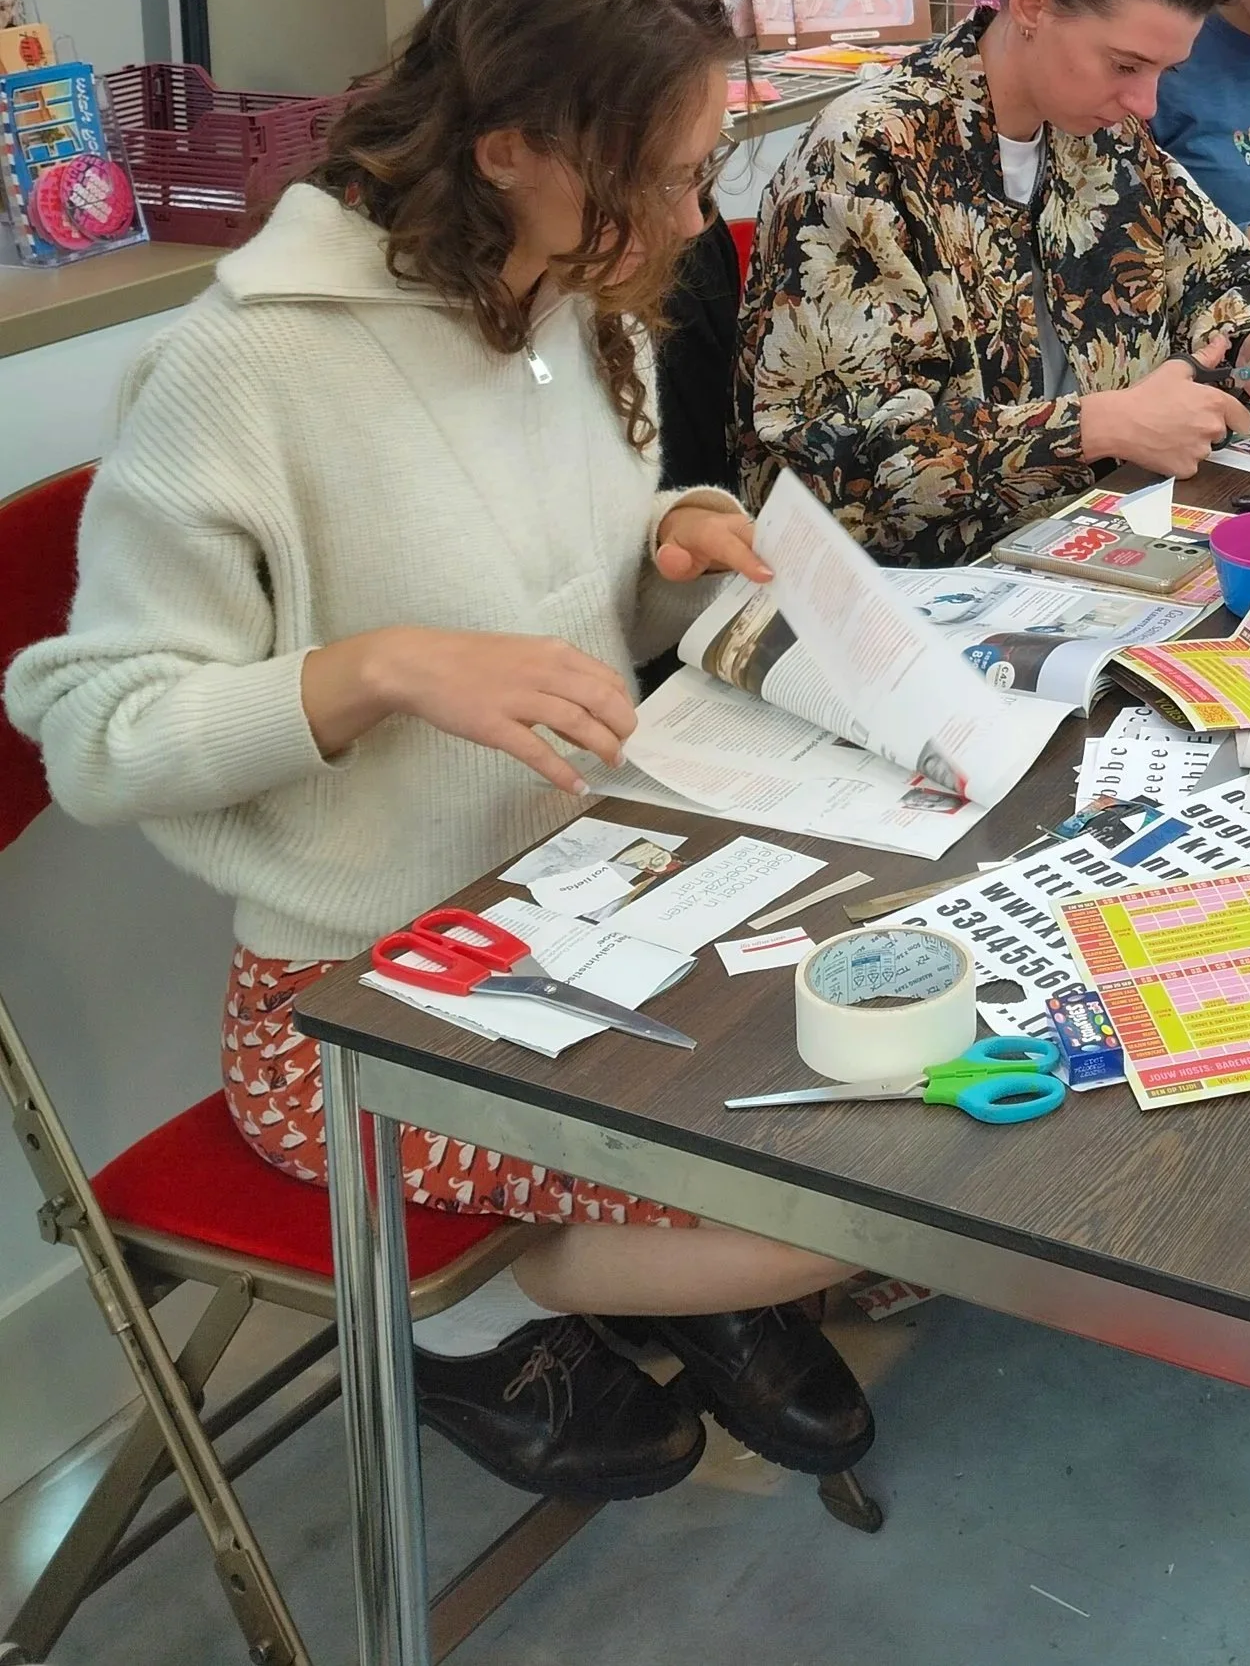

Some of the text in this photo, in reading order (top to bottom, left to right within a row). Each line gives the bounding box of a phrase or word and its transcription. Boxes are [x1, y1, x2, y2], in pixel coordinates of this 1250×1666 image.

[733, 843, 759, 860] niet
[715, 859, 734, 872] in
[559, 866, 609, 892] vol liefde
[658, 845, 776, 922] je broekzak zitten
[719, 875, 758, 899] moet
[704, 898, 722, 908] in
[1148, 1070, 1177, 1084] JOUW
[1179, 1065, 1215, 1080] HOSTS:
